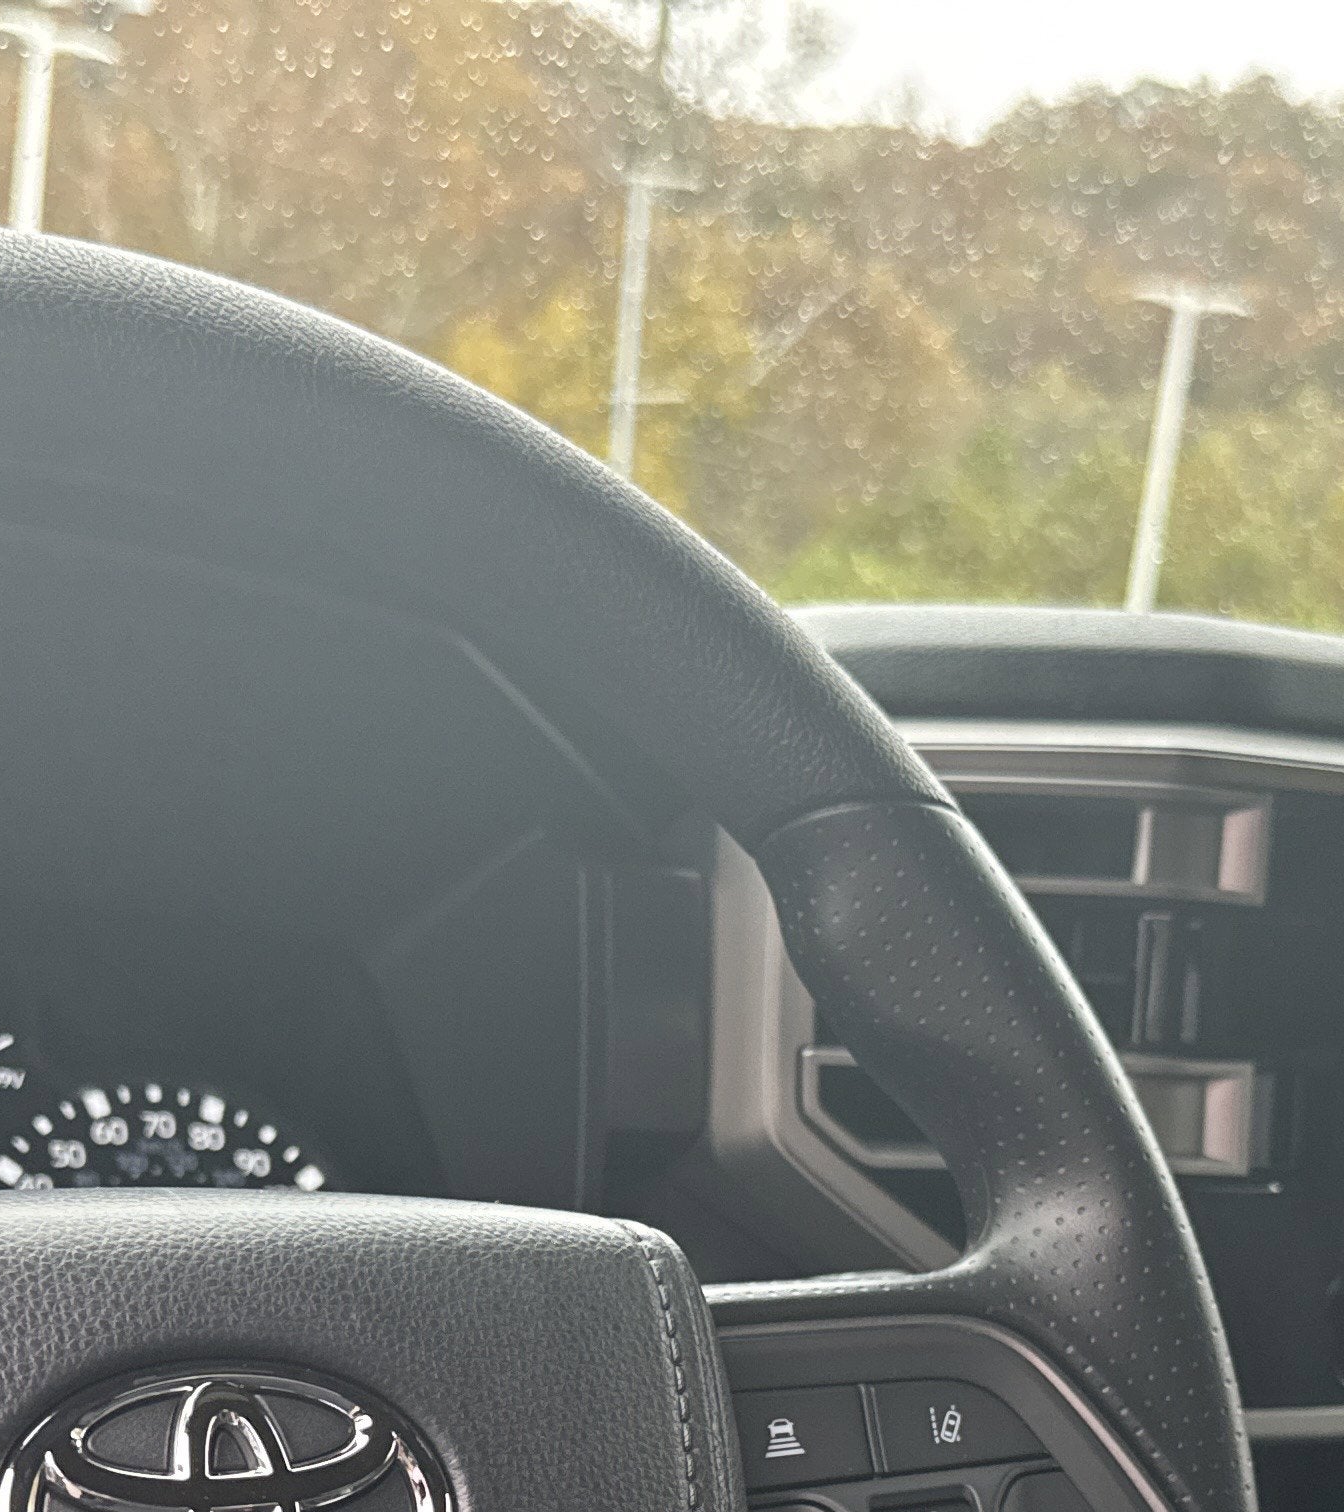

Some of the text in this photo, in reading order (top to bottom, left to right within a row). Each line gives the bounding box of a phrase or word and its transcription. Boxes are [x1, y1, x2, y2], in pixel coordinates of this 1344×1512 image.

[90, 1117, 129, 1146] 60
[140, 1110, 177, 1140] 70
[188, 1121, 226, 1151] 80
[48, 1139, 87, 1169] 50
[233, 1148, 272, 1178] 90
